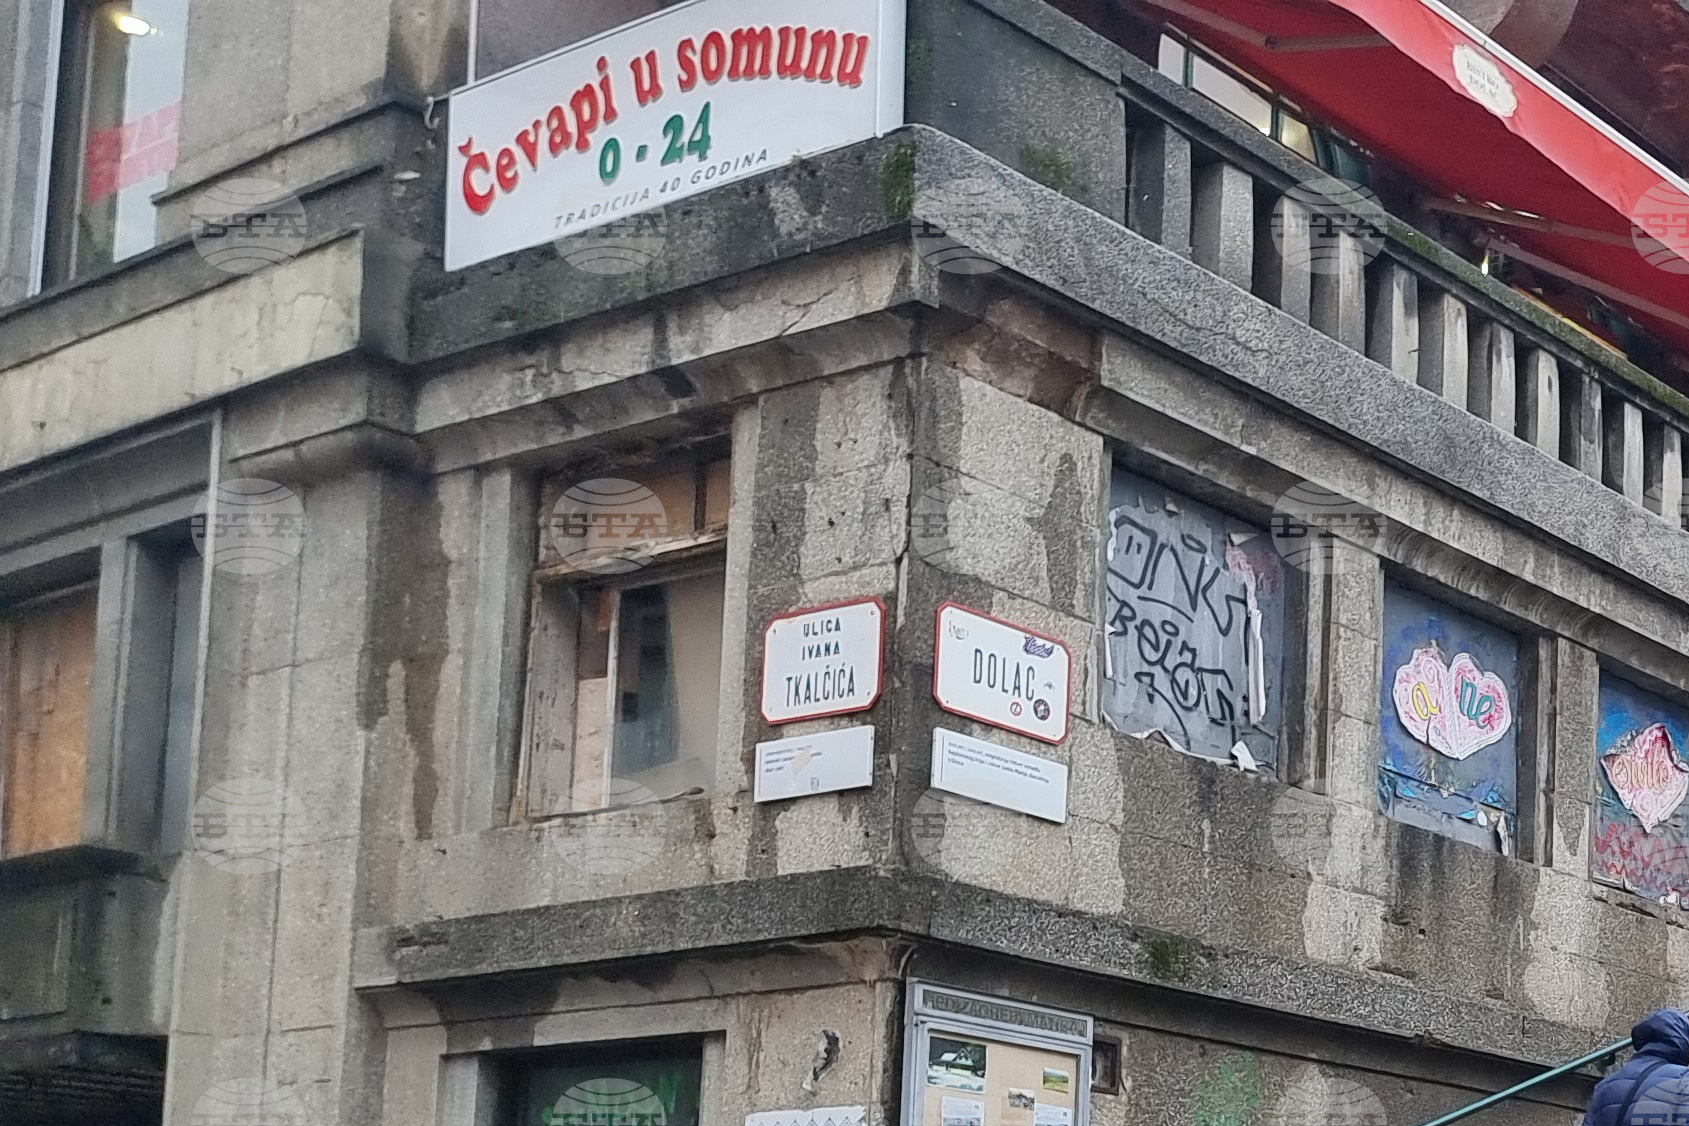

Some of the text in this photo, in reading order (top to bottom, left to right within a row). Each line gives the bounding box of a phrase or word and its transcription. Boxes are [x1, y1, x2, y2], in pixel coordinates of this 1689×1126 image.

[458, 25, 871, 216] Čevapi u somunu
[599, 136, 622, 187] 0
[659, 101, 712, 168] 24
[553, 147, 769, 230] TRADICIJA 40 GODINA
[802, 640, 841, 661] IVANA
[803, 616, 842, 637] ULICA
[785, 662, 856, 708] TKALČIĆA
[973, 648, 1036, 701] DOLAC
